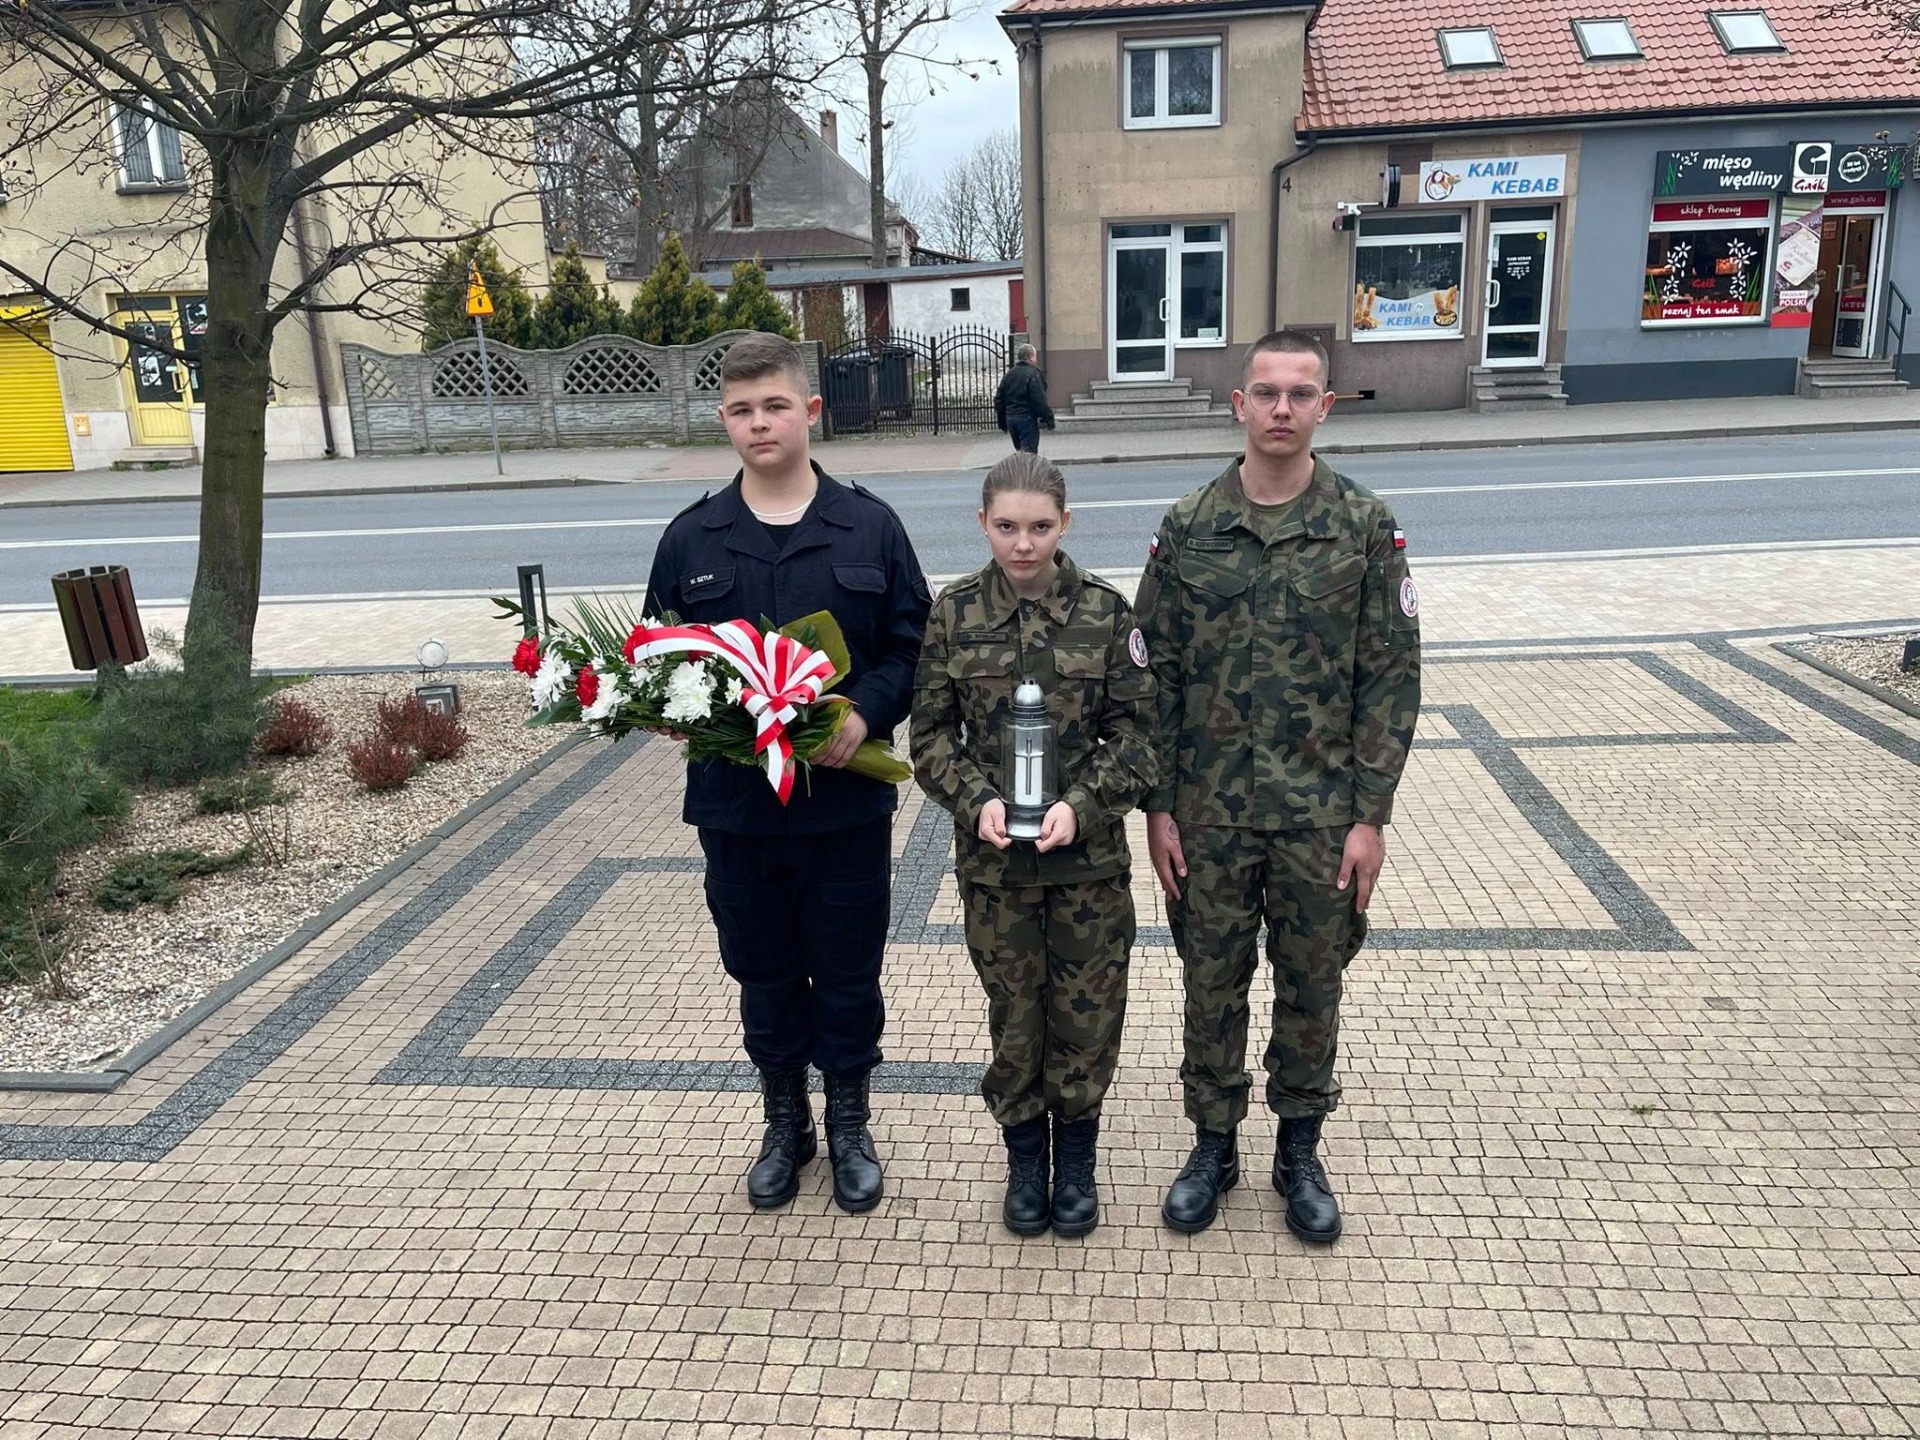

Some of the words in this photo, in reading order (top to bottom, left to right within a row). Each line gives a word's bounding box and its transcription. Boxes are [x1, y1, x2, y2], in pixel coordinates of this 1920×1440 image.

[1468, 161, 1519, 178] KAMI
[1702, 154, 1752, 173] mięso
[1282, 176, 1292, 193] 4
[1491, 178, 1560, 195] KEBAB
[1719, 171, 1783, 191] wędliny
[1794, 178, 1826, 191] Gaik
[1830, 195, 1877, 206] www.gaik.eu
[1680, 204, 1704, 218] sklep
[1707, 204, 1741, 217] firmowy
[1378, 303, 1411, 313] KAMI
[1779, 298, 1807, 307] POLSKI
[1662, 307, 1692, 318] poznaj
[1695, 305, 1711, 315] ten
[1715, 304, 1740, 315] smak
[1386, 315, 1430, 326] KEBAB
